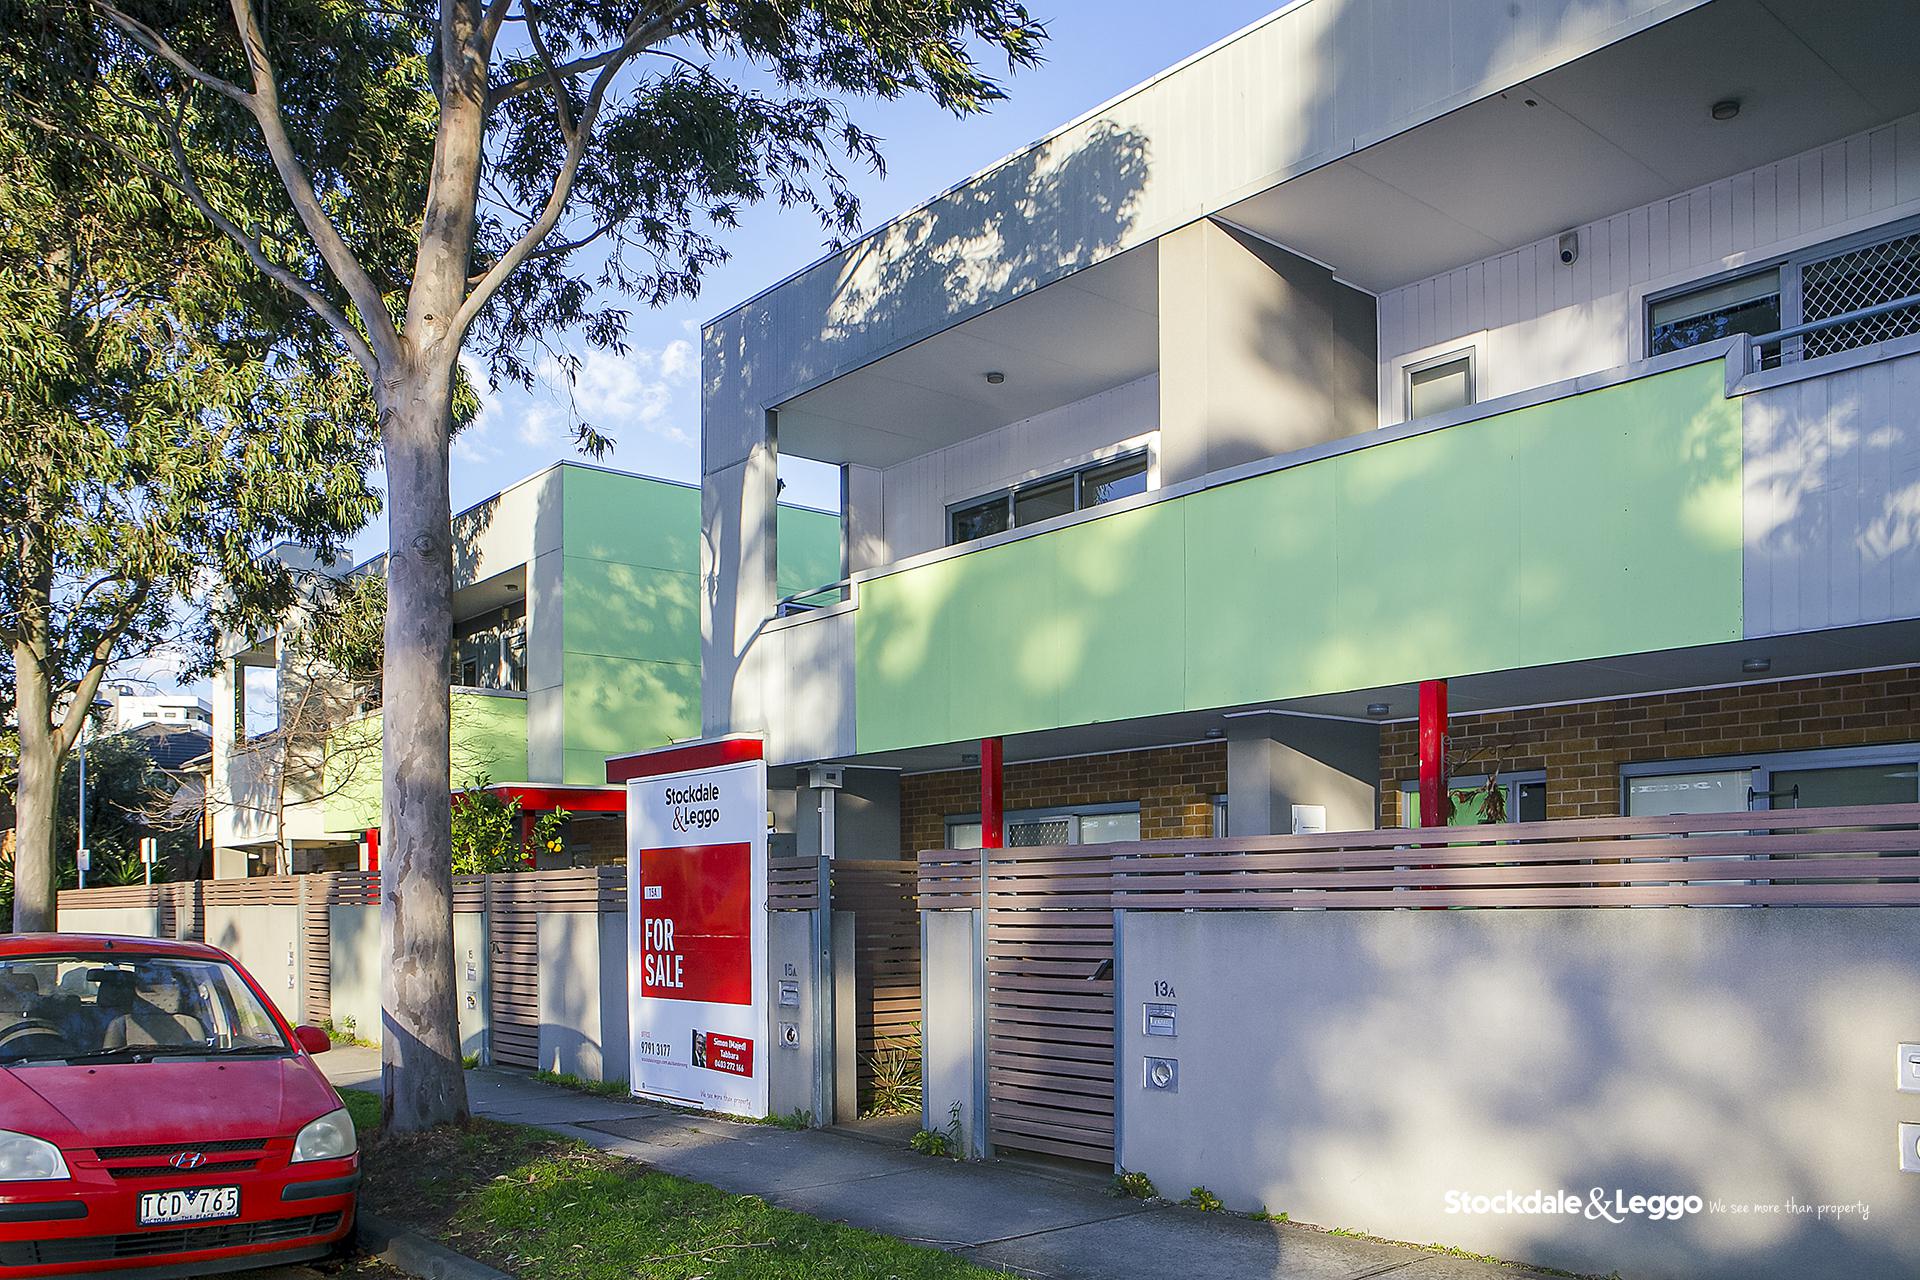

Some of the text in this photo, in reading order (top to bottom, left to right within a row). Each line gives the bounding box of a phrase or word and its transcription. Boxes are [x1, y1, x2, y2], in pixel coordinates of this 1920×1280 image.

[665, 782, 719, 806] Stockdale
[645, 918, 674, 951] FOR
[645, 953, 684, 988] SALE
[784, 963, 798, 977] 15A
[1153, 980, 1176, 998] 13A
[640, 1041, 671, 1057] 9791 3177
[143, 1190, 236, 1218] TCD 765
